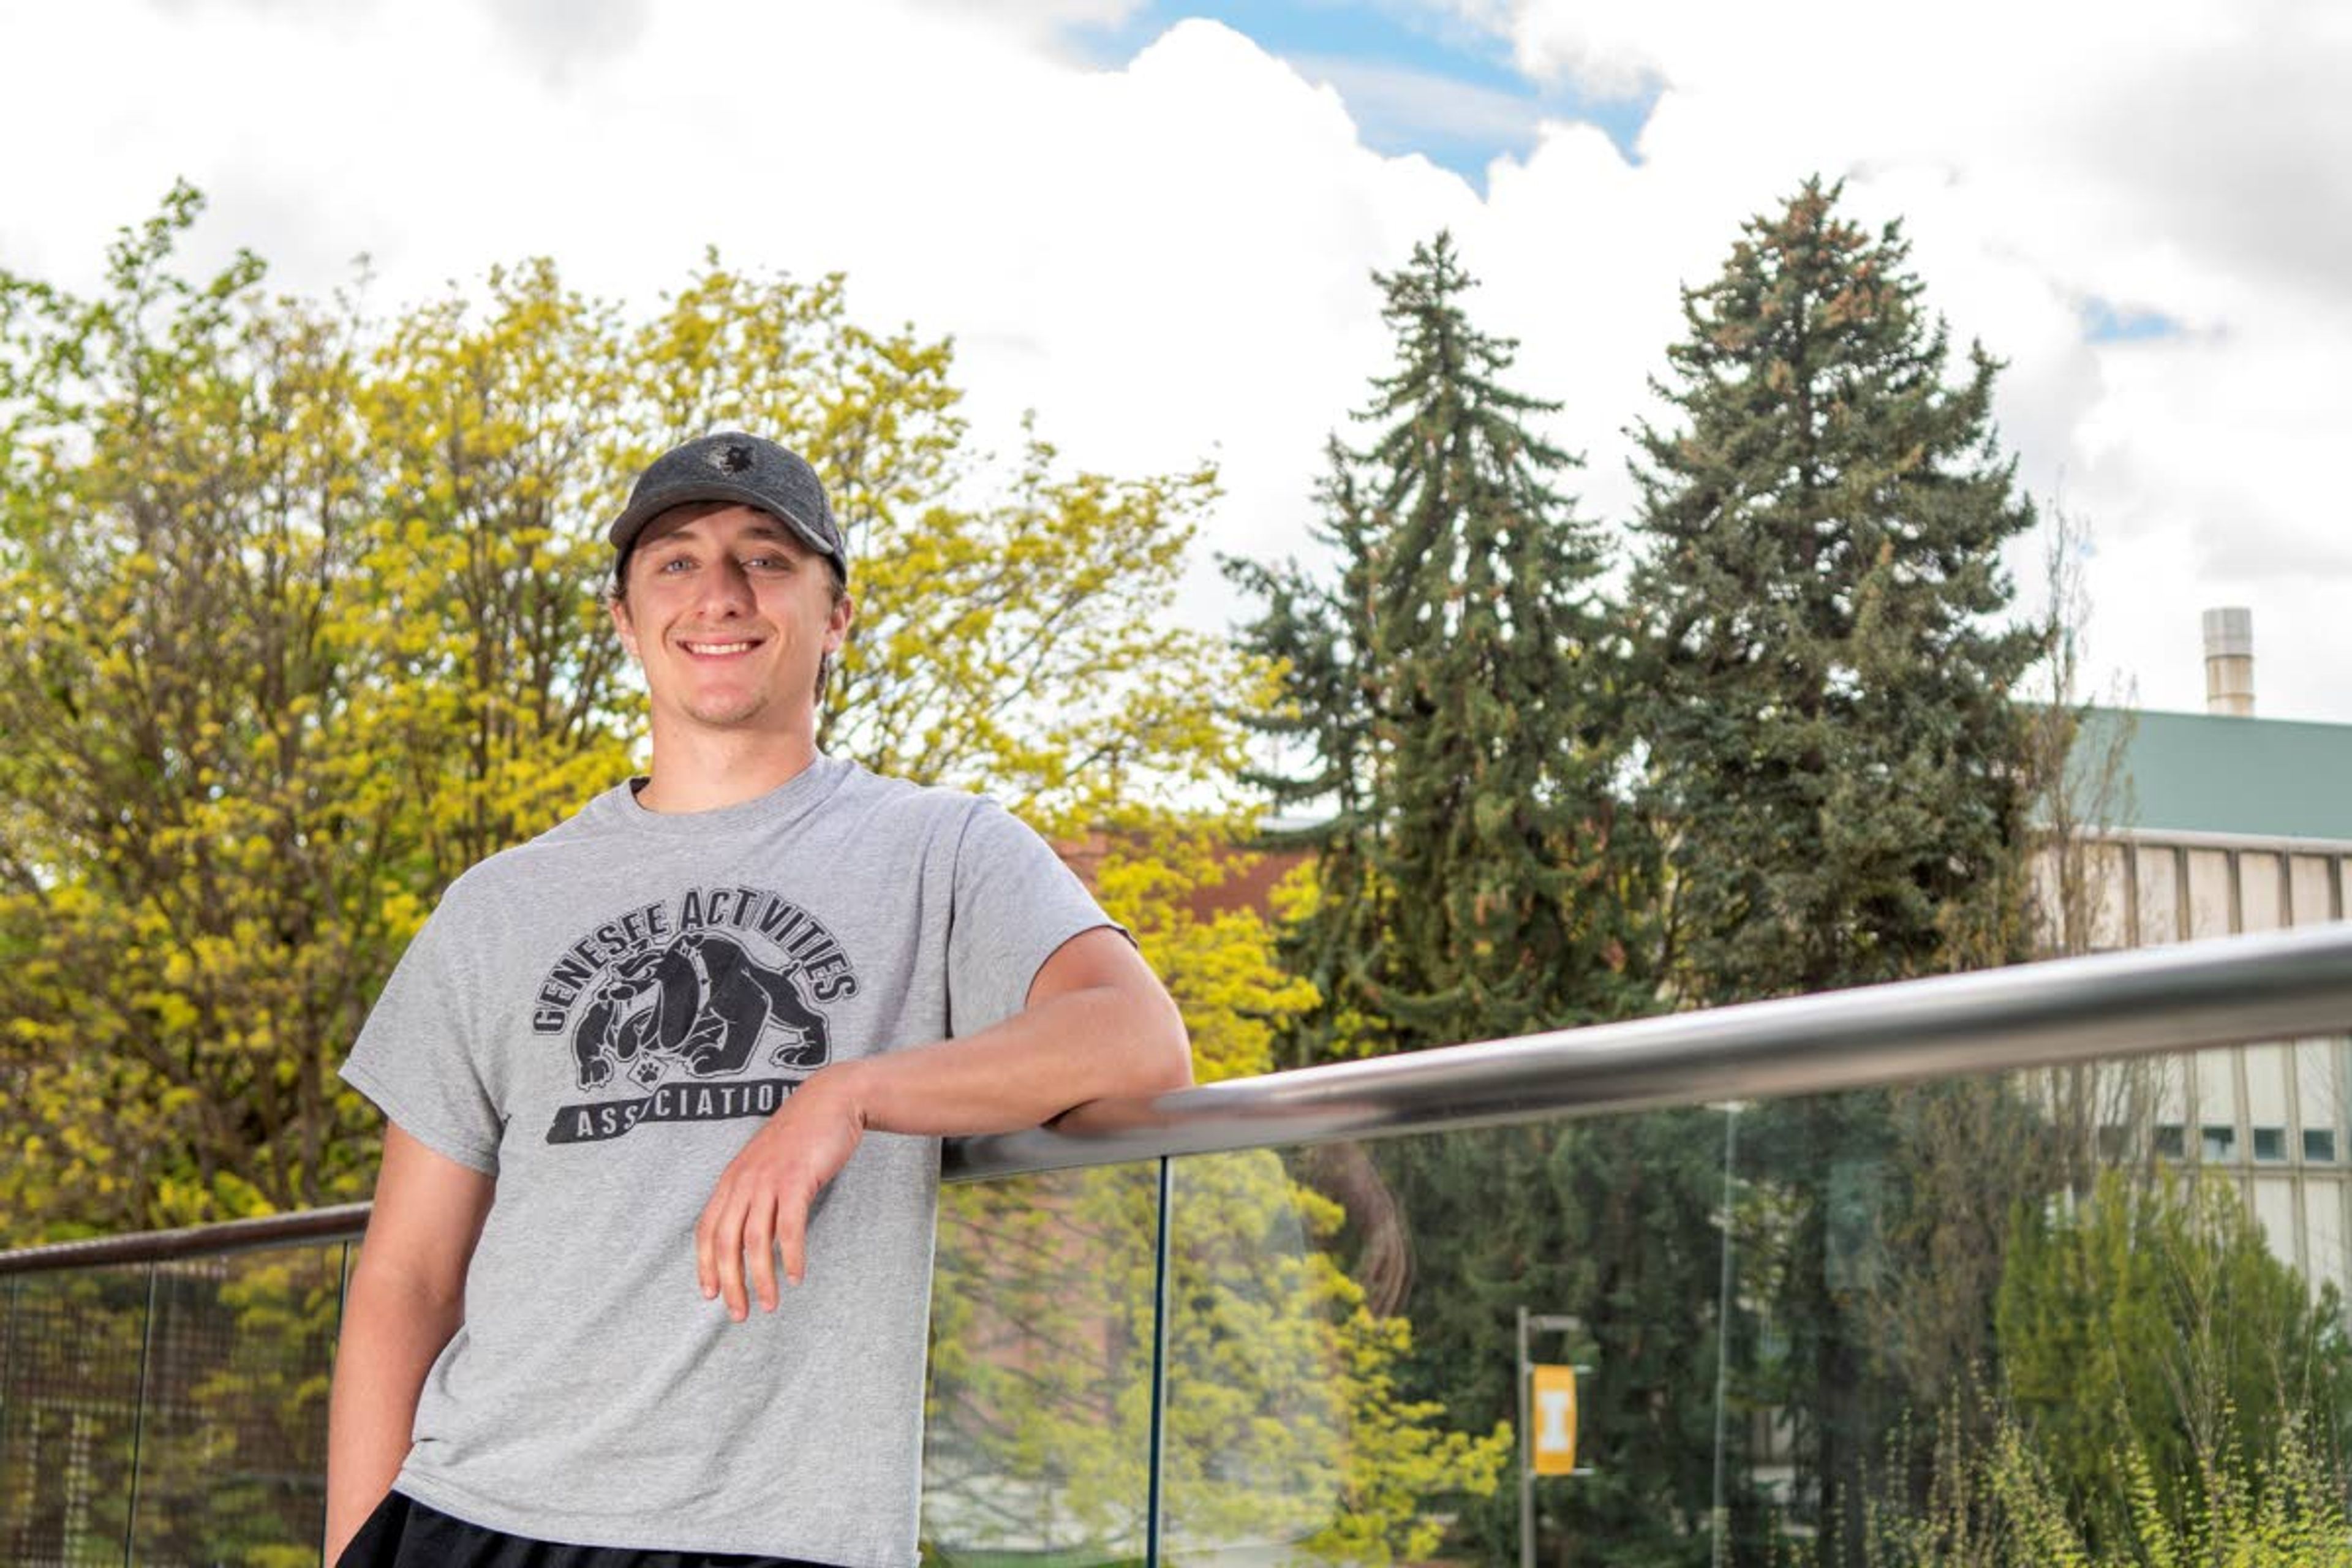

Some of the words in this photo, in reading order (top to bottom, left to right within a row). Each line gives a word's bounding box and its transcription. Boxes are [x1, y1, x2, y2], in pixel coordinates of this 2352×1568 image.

[680, 888, 858, 1001] ACTVITIES
[576, 1084, 799, 1137] ASSCIATION
[1538, 1391, 1569, 1452] I
